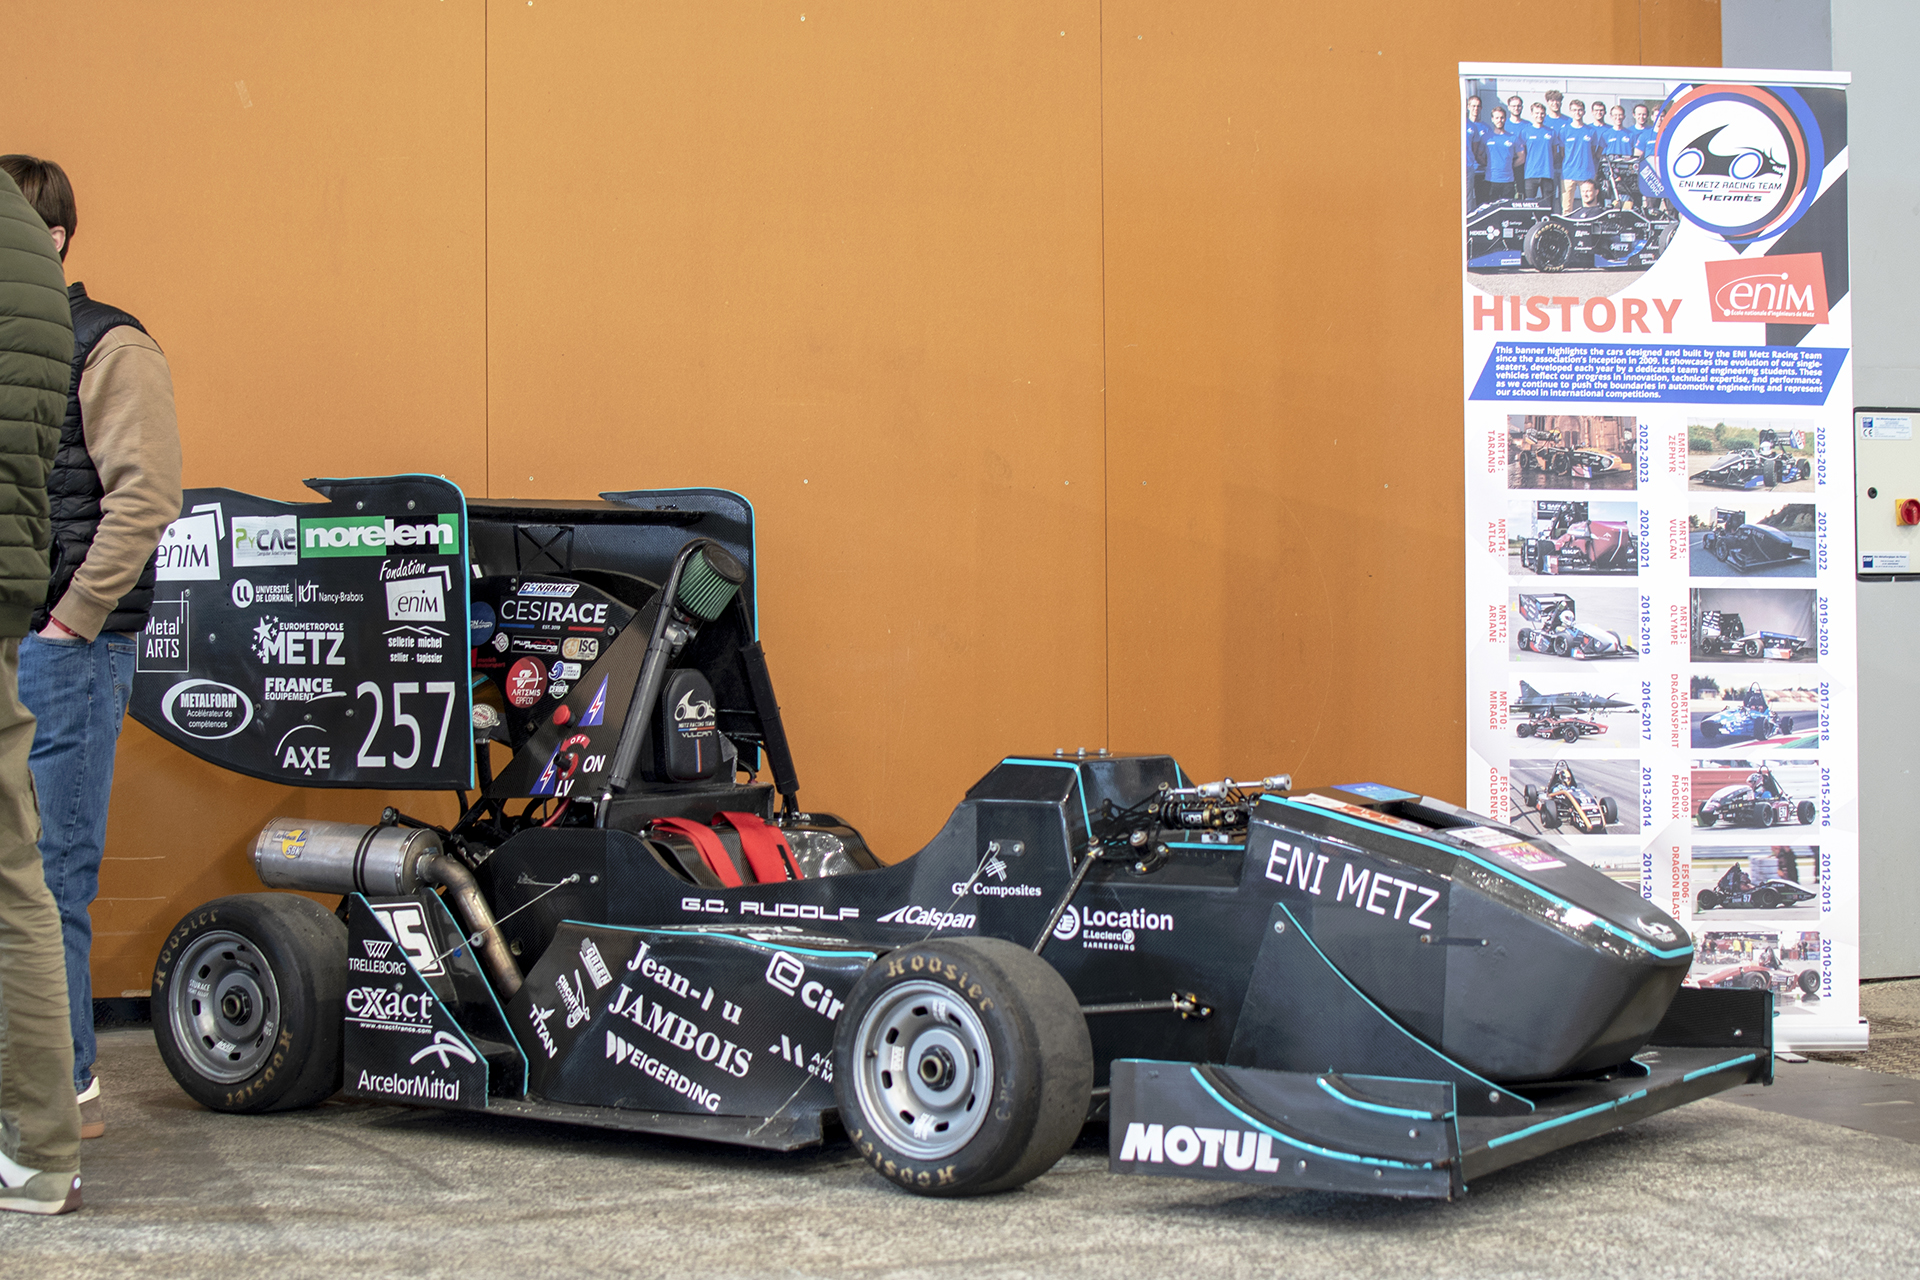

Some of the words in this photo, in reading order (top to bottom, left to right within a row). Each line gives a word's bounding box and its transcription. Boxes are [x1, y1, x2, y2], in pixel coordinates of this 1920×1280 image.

[1758, 182, 1781, 190] TEAM
[1472, 295, 1683, 334] HISTORY
[1496, 346, 1513, 354] This
[1515, 346, 1545, 355] banner
[1547, 347, 1588, 356] highlights
[1590, 347, 1604, 355] the
[1606, 348, 1623, 356] cars
[1626, 348, 1662, 358] designed
[1665, 349, 1680, 357] and
[1772, 351, 1798, 361] Racing
[1496, 355, 1517, 363] since
[1519, 355, 1533, 363] the
[1535, 355, 1586, 364] association's
[1589, 356, 1626, 366] inception
[1671, 358, 1712, 366] showcases
[1797, 360, 1822, 369] single-
[1488, 430, 1496, 474] TARANIS
[1639, 424, 1648, 483] 2022-2023
[1668, 435, 1676, 473] ZÉPHYR
[1817, 427, 1826, 485] 2023-2024
[305, 519, 453, 548] norelem
[1488, 522, 1496, 554] ATLAS
[1640, 510, 1649, 568] 2020-2021
[1818, 512, 1827, 570] 2021-2022
[379, 558, 426, 581] Fondation
[256, 584, 289, 594] UNIVERSITÉ
[256, 593, 264, 602] DE
[265, 593, 294, 602] LORRAINE
[298, 580, 319, 602] IUT
[319, 591, 364, 604] Nancy-Brabois
[146, 616, 179, 635] Metal
[279, 622, 344, 631] EUROMETROPOLE
[501, 600, 608, 624] CESIRACE
[1489, 605, 1497, 643] ARIANE
[1641, 595, 1650, 655] 2018-2019
[1670, 605, 1678, 645] OLYMPE
[1820, 596, 1828, 656] 2019-2020
[146, 639, 179, 658] ARTS
[262, 631, 346, 665] METZ
[388, 636, 415, 648] sellerie
[417, 637, 442, 648] michel
[578, 640, 596, 652] ISC
[390, 652, 409, 662] sellier
[416, 653, 443, 663] tapissier
[265, 677, 333, 692] FRANCE
[265, 692, 314, 701] EQUIPEMENT
[180, 693, 237, 708] METALFORM
[186, 709, 223, 718] Accélérateur
[225, 710, 232, 718] de
[1642, 681, 1651, 741] 2016-2017
[1671, 673, 1679, 748] DRAGONSPIRIT
[1820, 682, 1829, 741] 2017-2018
[188, 719, 228, 728] compétences
[356, 681, 456, 768] 257
[569, 734, 586, 745] OFF
[282, 746, 331, 769] AXE
[582, 755, 606, 773] ON
[554, 779, 575, 797] LV
[1642, 767, 1651, 827] 2013-2014
[1821, 767, 1830, 827] 2015-2016
[1672, 846, 1680, 885] DRAGON
[1681, 864, 1689, 880] EFS
[973, 882, 1042, 898] Composites
[1263, 840, 1331, 894] ENI
[1336, 860, 1441, 931] METZ
[1822, 854, 1831, 913] 2012-2013
[681, 897, 729, 914] G.C.
[740, 901, 860, 921] RUDOLF
[905, 905, 976, 930] Calspan
[1083, 906, 1174, 931] Location
[1672, 888, 1680, 920] BLAST
[1083, 929, 1122, 942] E.Leclerc
[1083, 942, 1135, 952] SARREBOURG
[349, 958, 406, 976] TRELLEBORG
[585, 947, 609, 984] GREEN
[1823, 939, 1832, 998] 2010-2011
[558, 974, 579, 1009] CIRCUIT
[529, 1004, 558, 1059] TITAN
[608, 983, 753, 1078] JAMBOIS
[357, 1069, 460, 1101] ArcelorMittal
[606, 1030, 722, 1113] WEIGERDING
[1119, 1122, 1280, 1174] MOTUL
